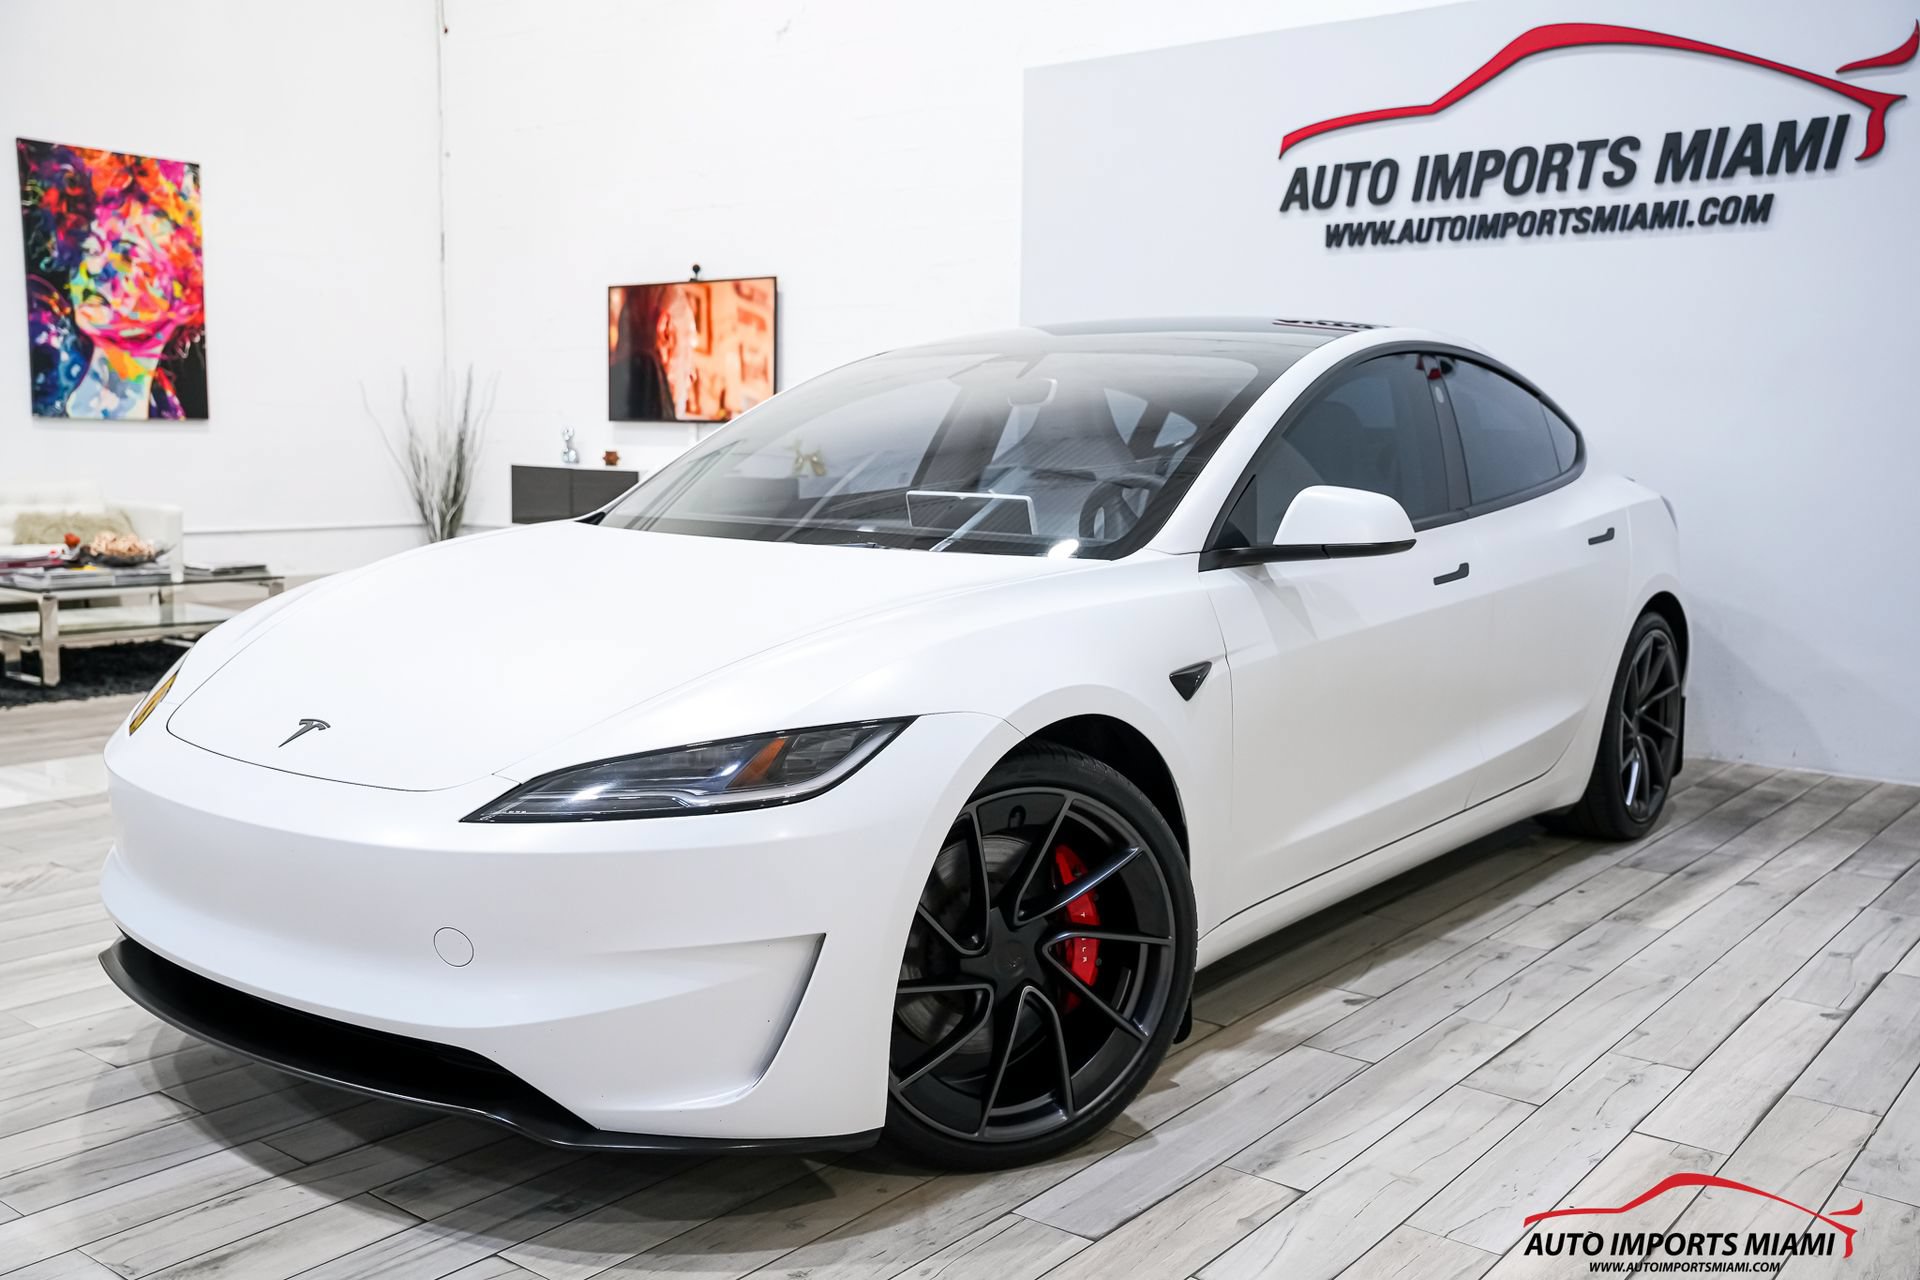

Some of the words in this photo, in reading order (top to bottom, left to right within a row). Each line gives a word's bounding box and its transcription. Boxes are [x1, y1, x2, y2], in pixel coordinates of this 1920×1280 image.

[1280, 158, 1399, 213] AUTO
[1411, 135, 1642, 203] IMPORTS
[1654, 113, 1851, 184] MIAMI
[1325, 193, 1775, 248] WWW.AUTOIMPORTSMIAMI.COM
